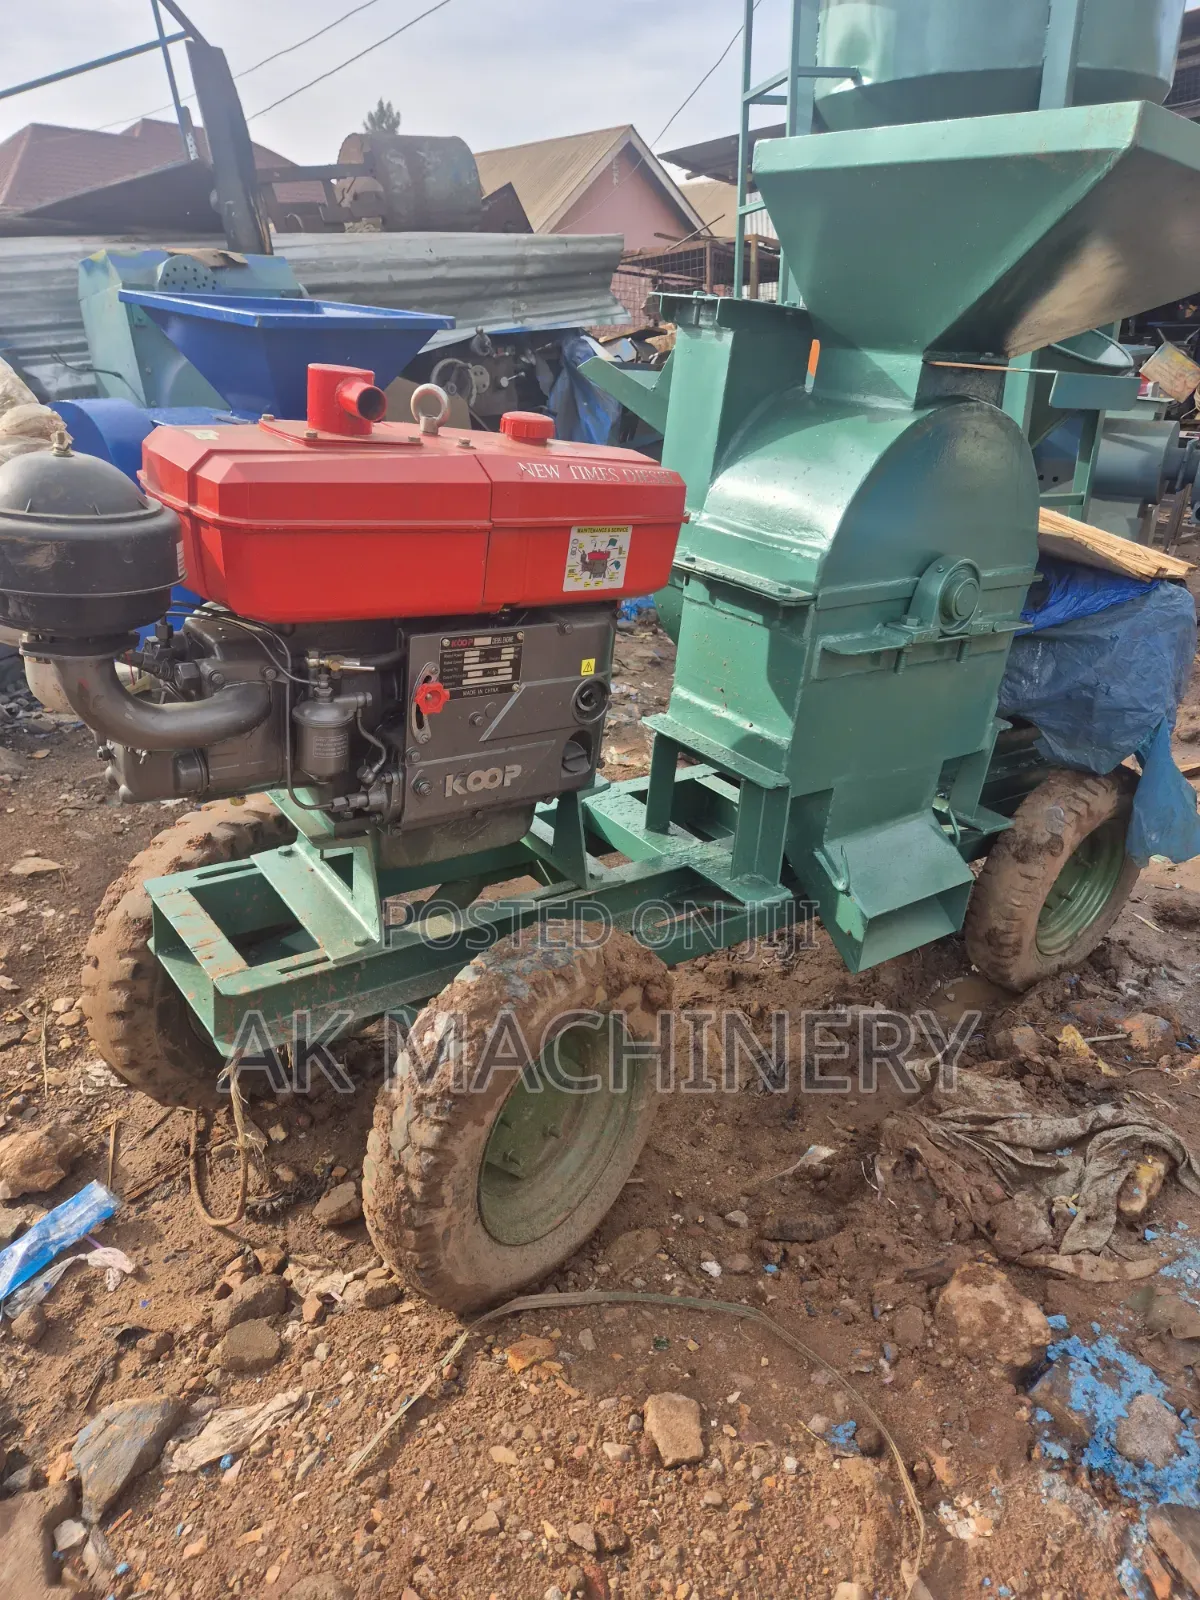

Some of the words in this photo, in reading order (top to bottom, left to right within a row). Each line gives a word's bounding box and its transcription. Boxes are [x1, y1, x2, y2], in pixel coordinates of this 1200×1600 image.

[517, 461, 561, 480] NEW
[569, 465, 621, 483] TIMES
[622, 468, 680, 486] DIESEL
[451, 638, 474, 648] KOOP
[462, 688, 476, 697] MADE
[444, 764, 522, 798] KOOP
